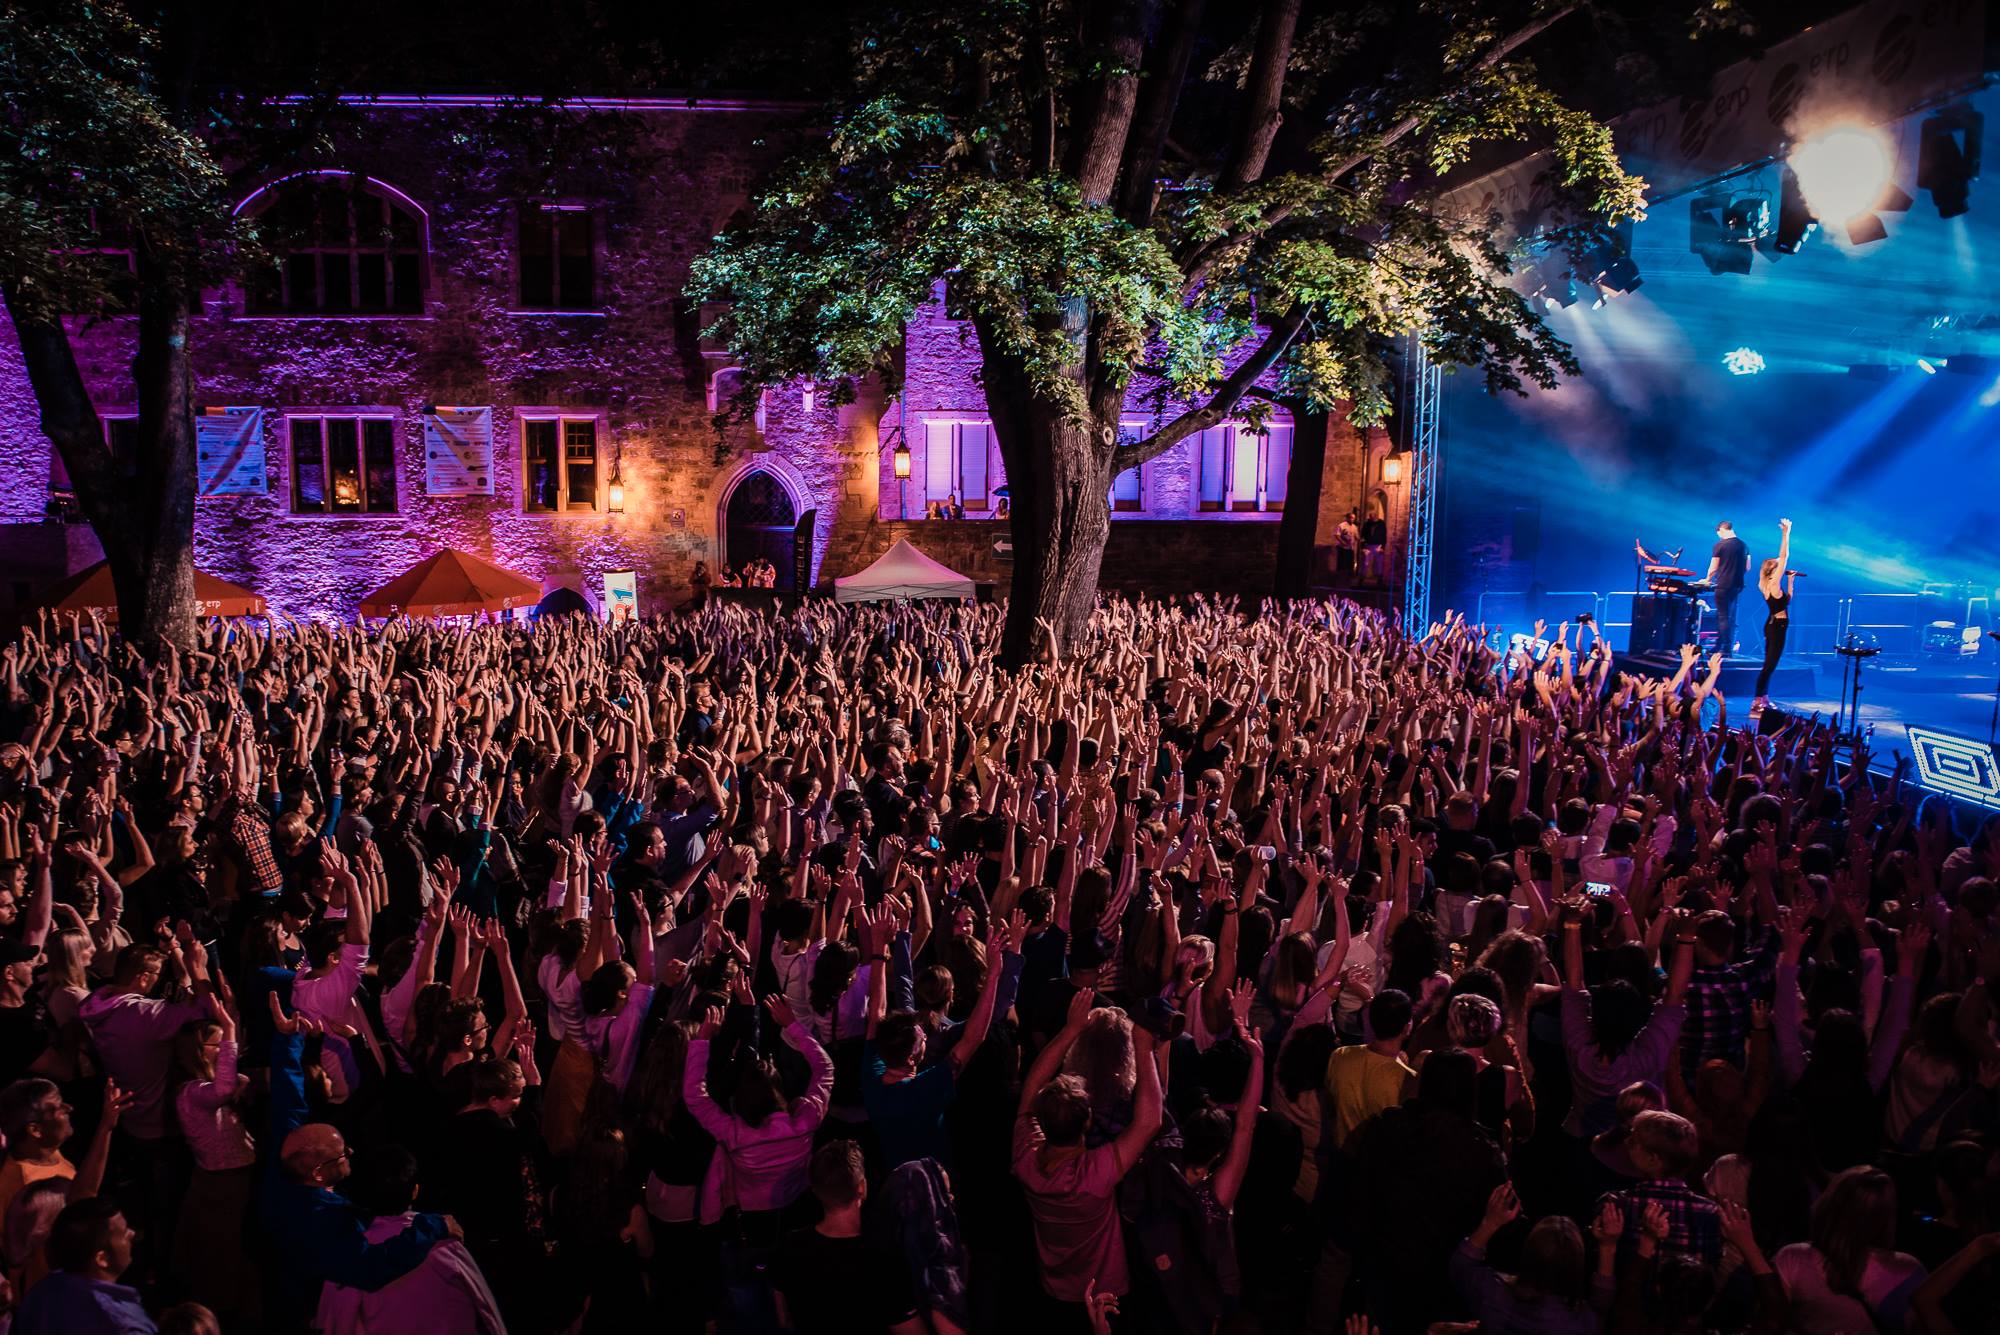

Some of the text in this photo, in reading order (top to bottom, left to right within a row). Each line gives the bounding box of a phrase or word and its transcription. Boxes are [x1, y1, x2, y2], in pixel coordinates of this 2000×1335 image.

[1809, 41, 1849, 77] erp
[1714, 86, 1750, 117] erp
[206, 600, 221, 609] erp
